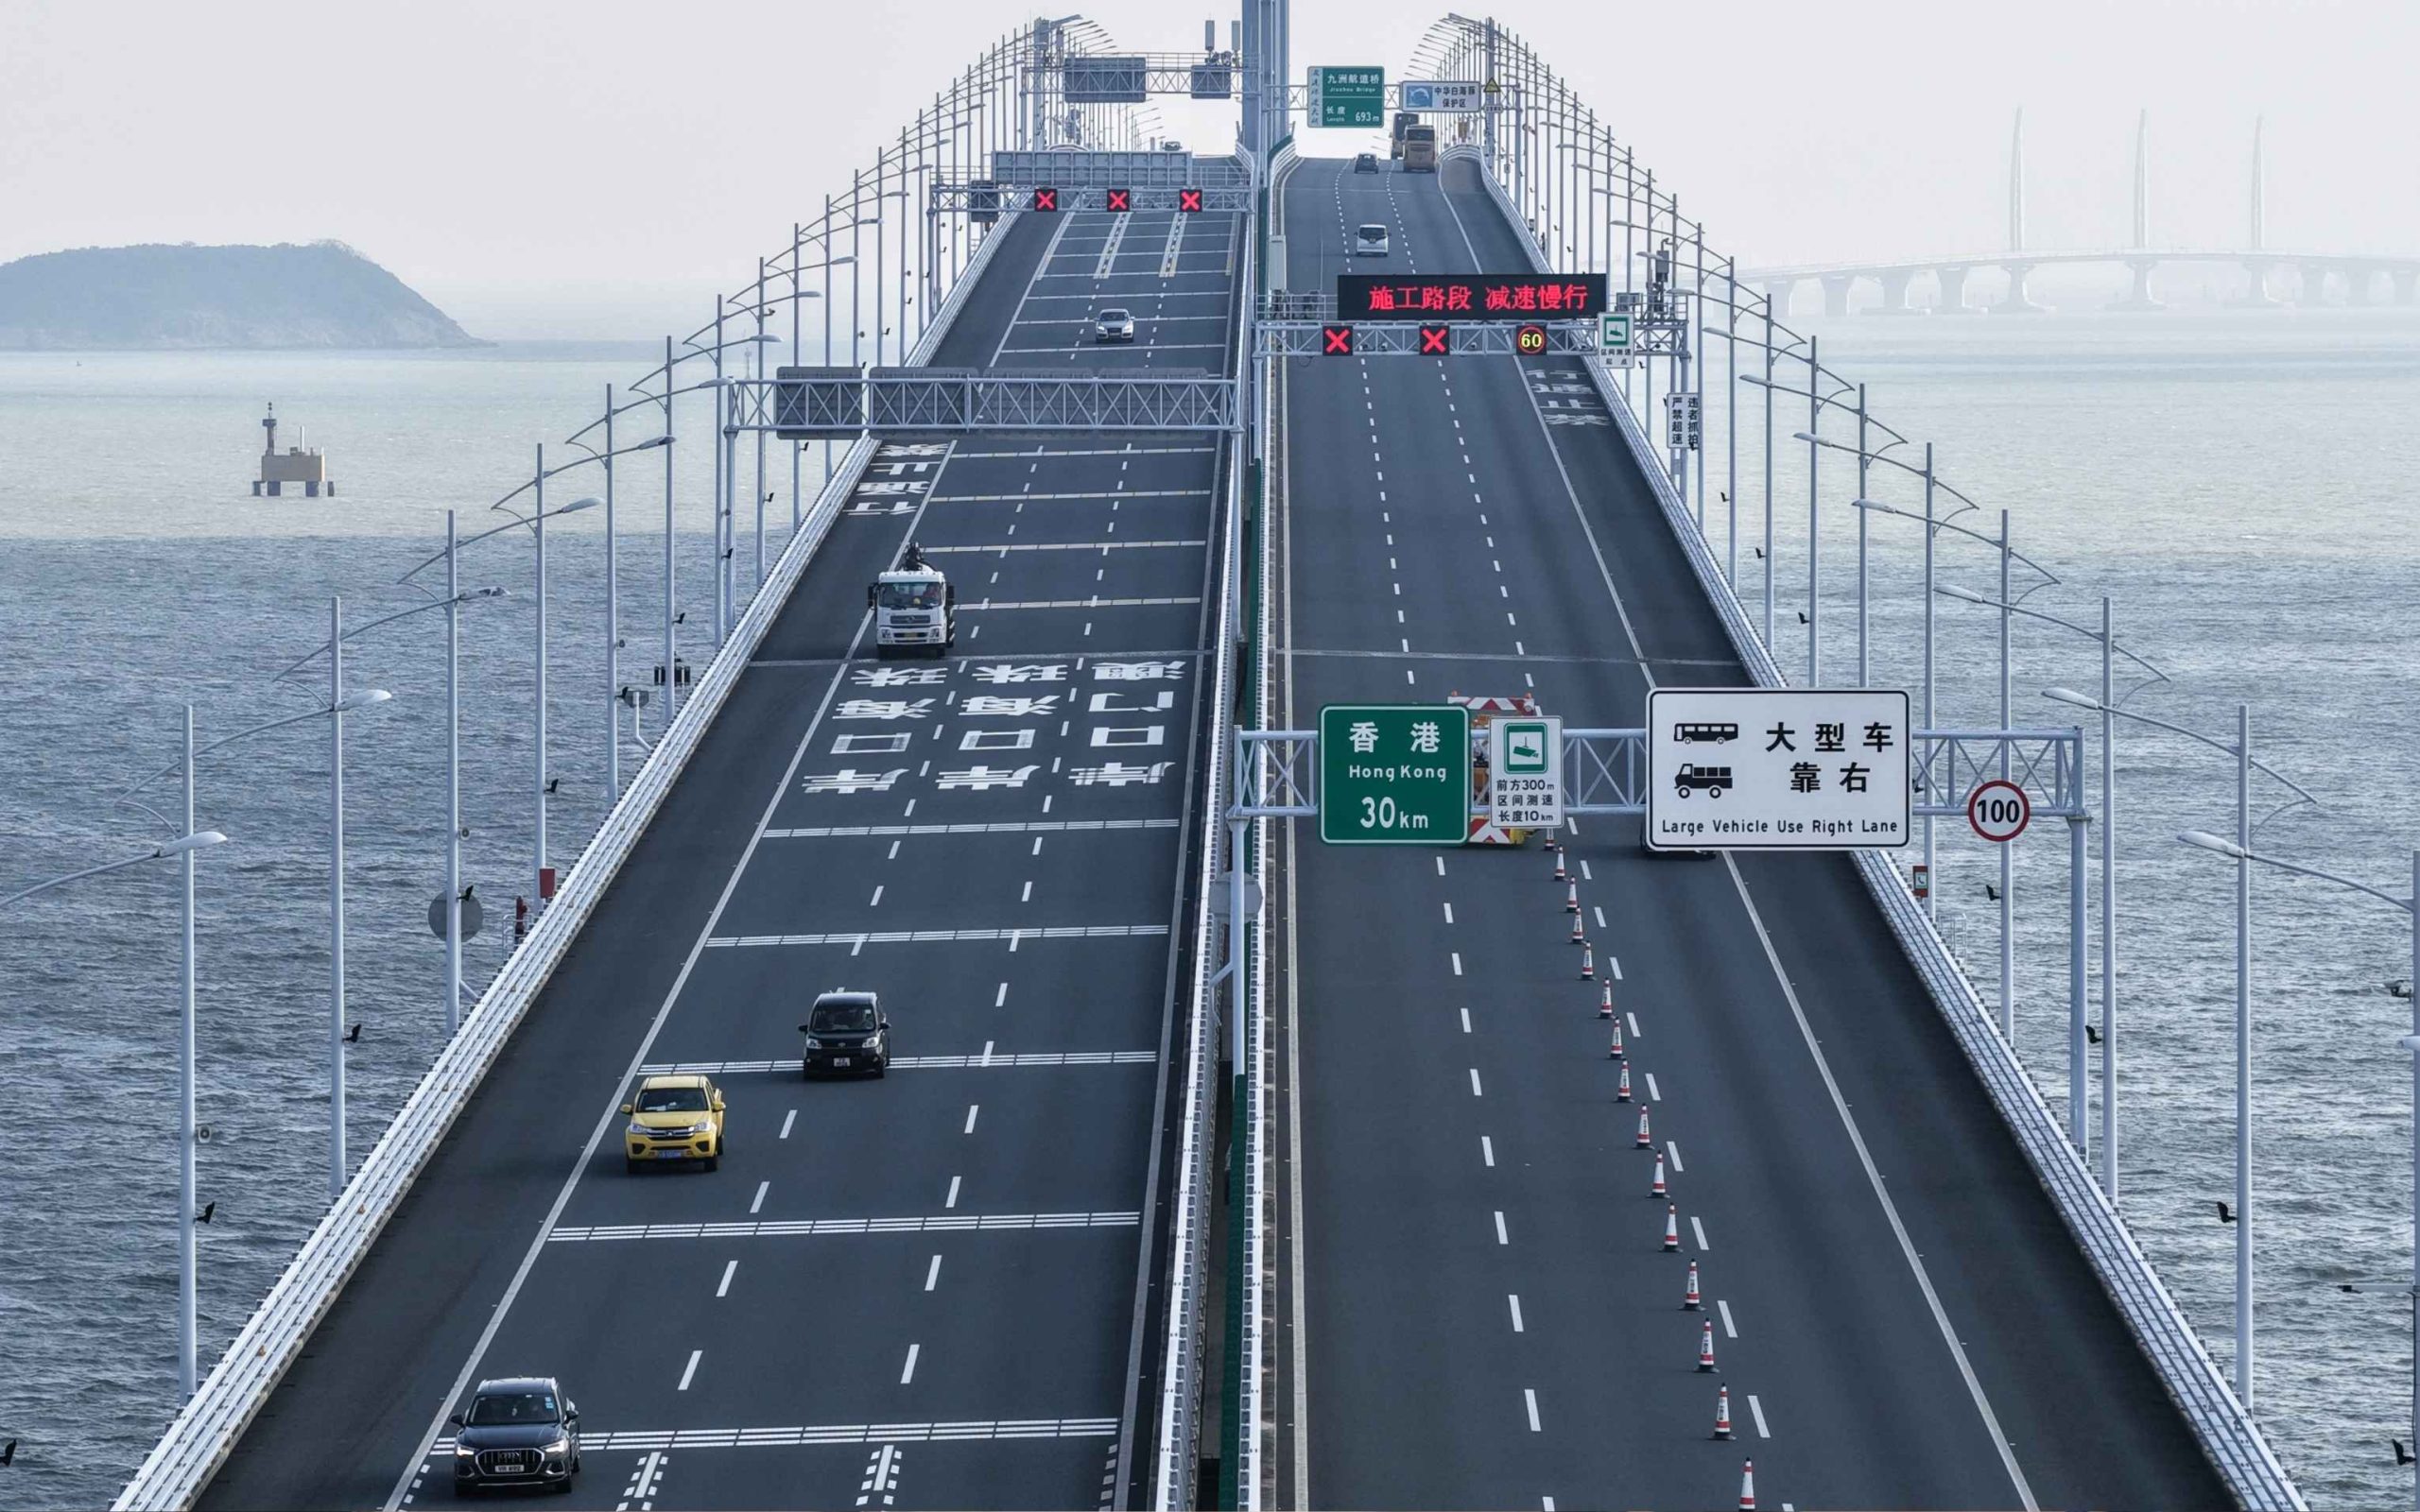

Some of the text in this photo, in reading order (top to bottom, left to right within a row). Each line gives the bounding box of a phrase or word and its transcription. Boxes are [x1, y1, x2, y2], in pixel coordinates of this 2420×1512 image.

[1434, 86, 1476, 95] 中华白海豚
[1326, 106, 1346, 115] 长度
[1442, 98, 1467, 108] 保护区
[1369, 284, 1588, 311] 施工路段 减速慢行
[1520, 334, 1543, 349] 60
[1672, 397, 1683, 444] 严禁超速
[1349, 722, 1441, 753] 香港
[1765, 722, 1893, 753] 大型车
[1349, 765, 1447, 782] Hong Kong
[1789, 762, 1871, 794] 靠右
[1498, 795, 1553, 806] 区间测速
[1977, 799, 2020, 824] 100
[1662, 819, 1898, 836] Large Vehicle Use Right Lane
